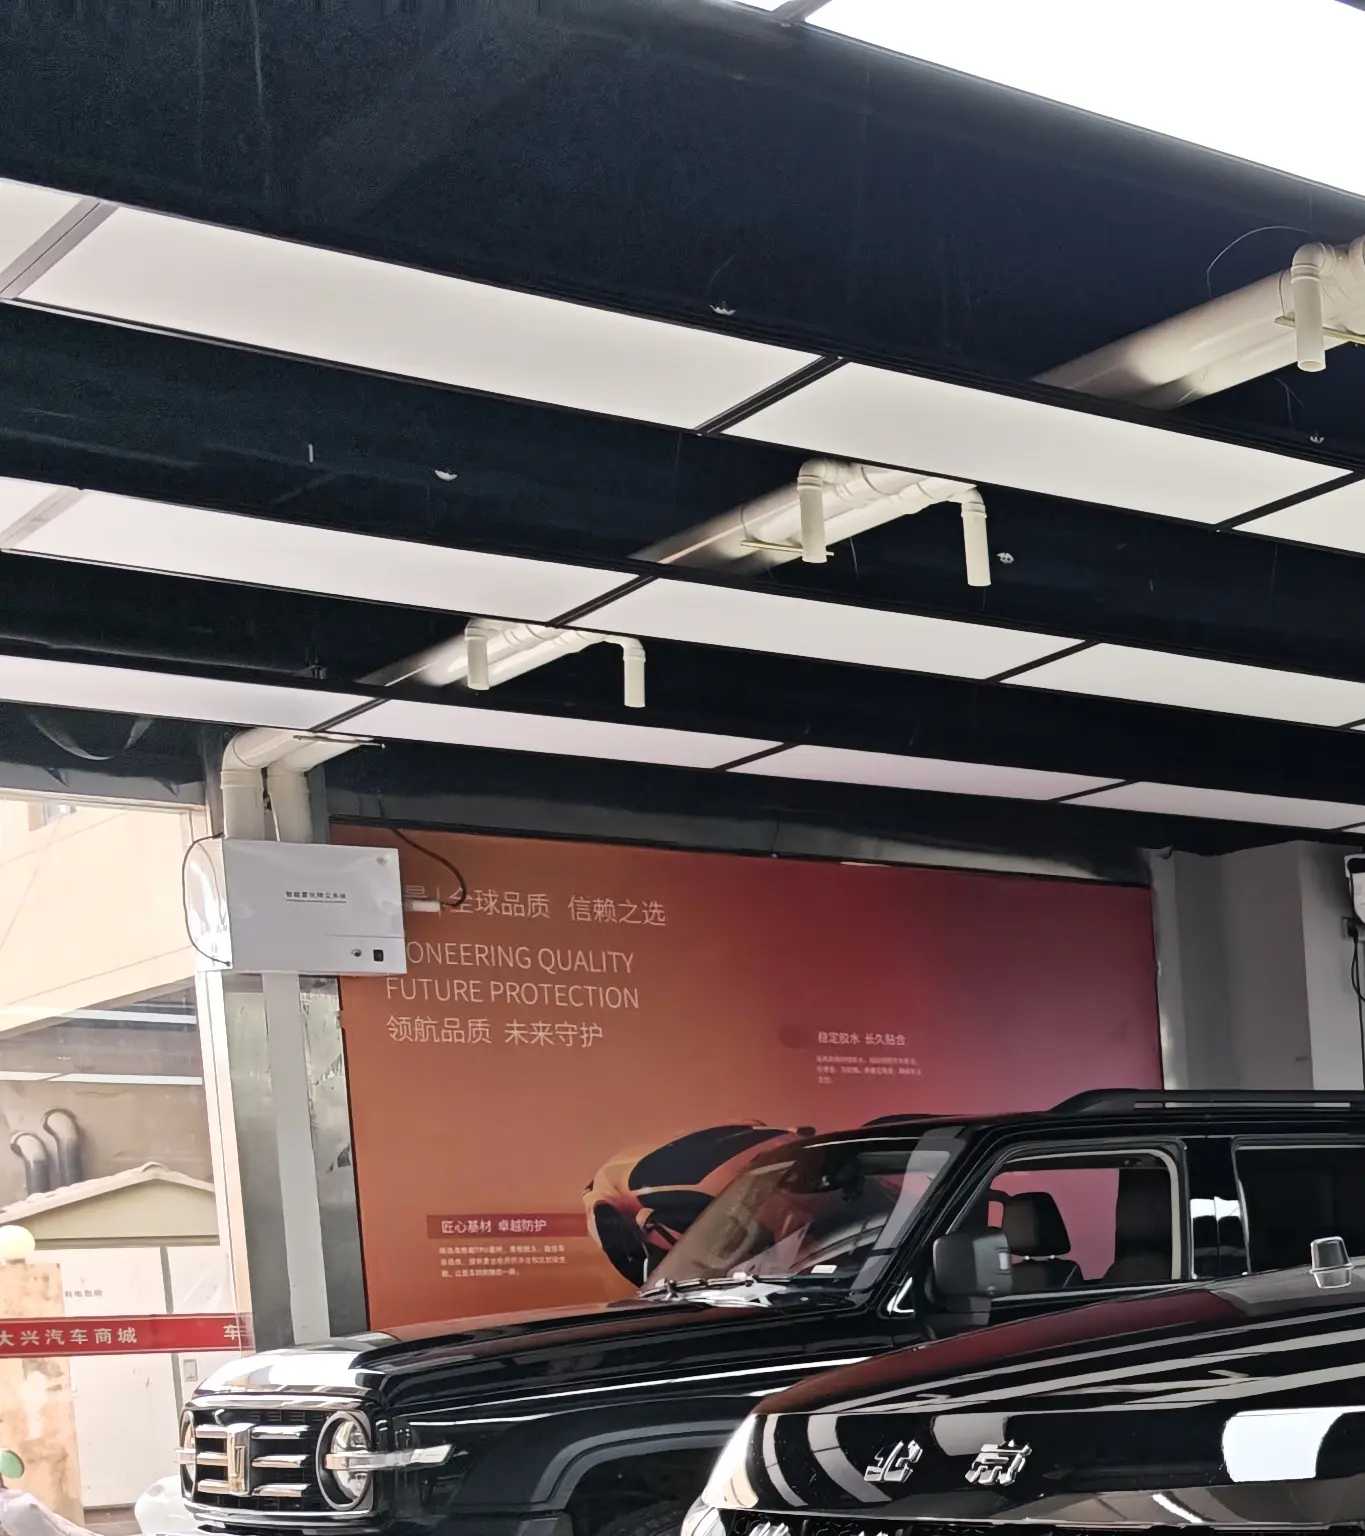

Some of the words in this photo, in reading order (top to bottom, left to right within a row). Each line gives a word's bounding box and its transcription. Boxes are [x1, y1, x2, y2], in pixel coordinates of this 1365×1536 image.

[568, 894, 667, 926] 信赖之选
[407, 941, 532, 970] ONEERING
[537, 948, 634, 975] QUALITY
[386, 977, 483, 1003] FUTURE
[489, 981, 640, 1009] PROTECTION
[386, 1014, 492, 1044] 领航品质
[504, 1018, 603, 1048] 未来守护
